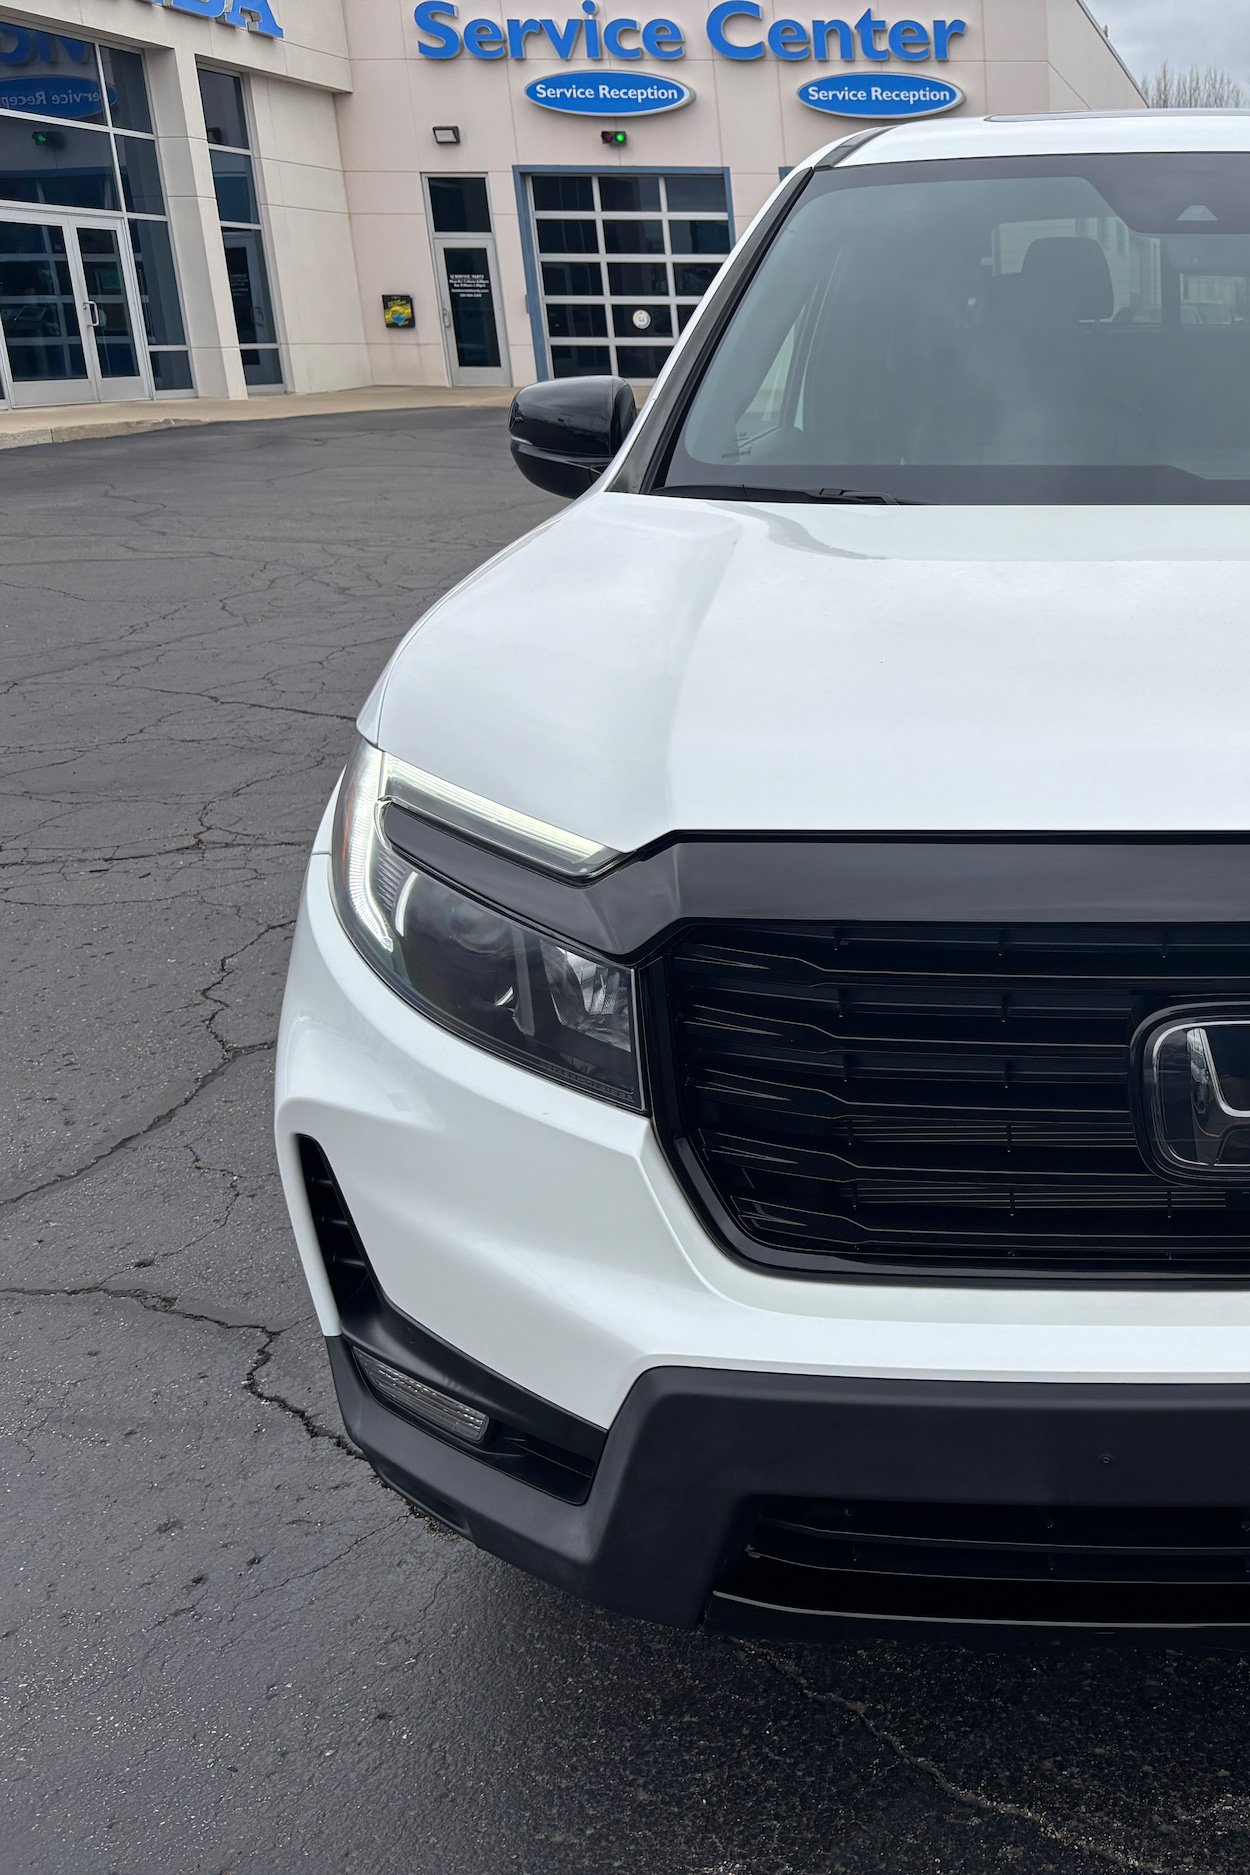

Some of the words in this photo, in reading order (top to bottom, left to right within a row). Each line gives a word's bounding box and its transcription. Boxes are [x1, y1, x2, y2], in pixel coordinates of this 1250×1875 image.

[414, 0, 686, 61] Service
[706, 0, 968, 62] Center
[535, 84, 595, 99] Service
[599, 84, 679, 103] Reception
[808, 86, 867, 101] Service
[871, 86, 951, 104] Reception
